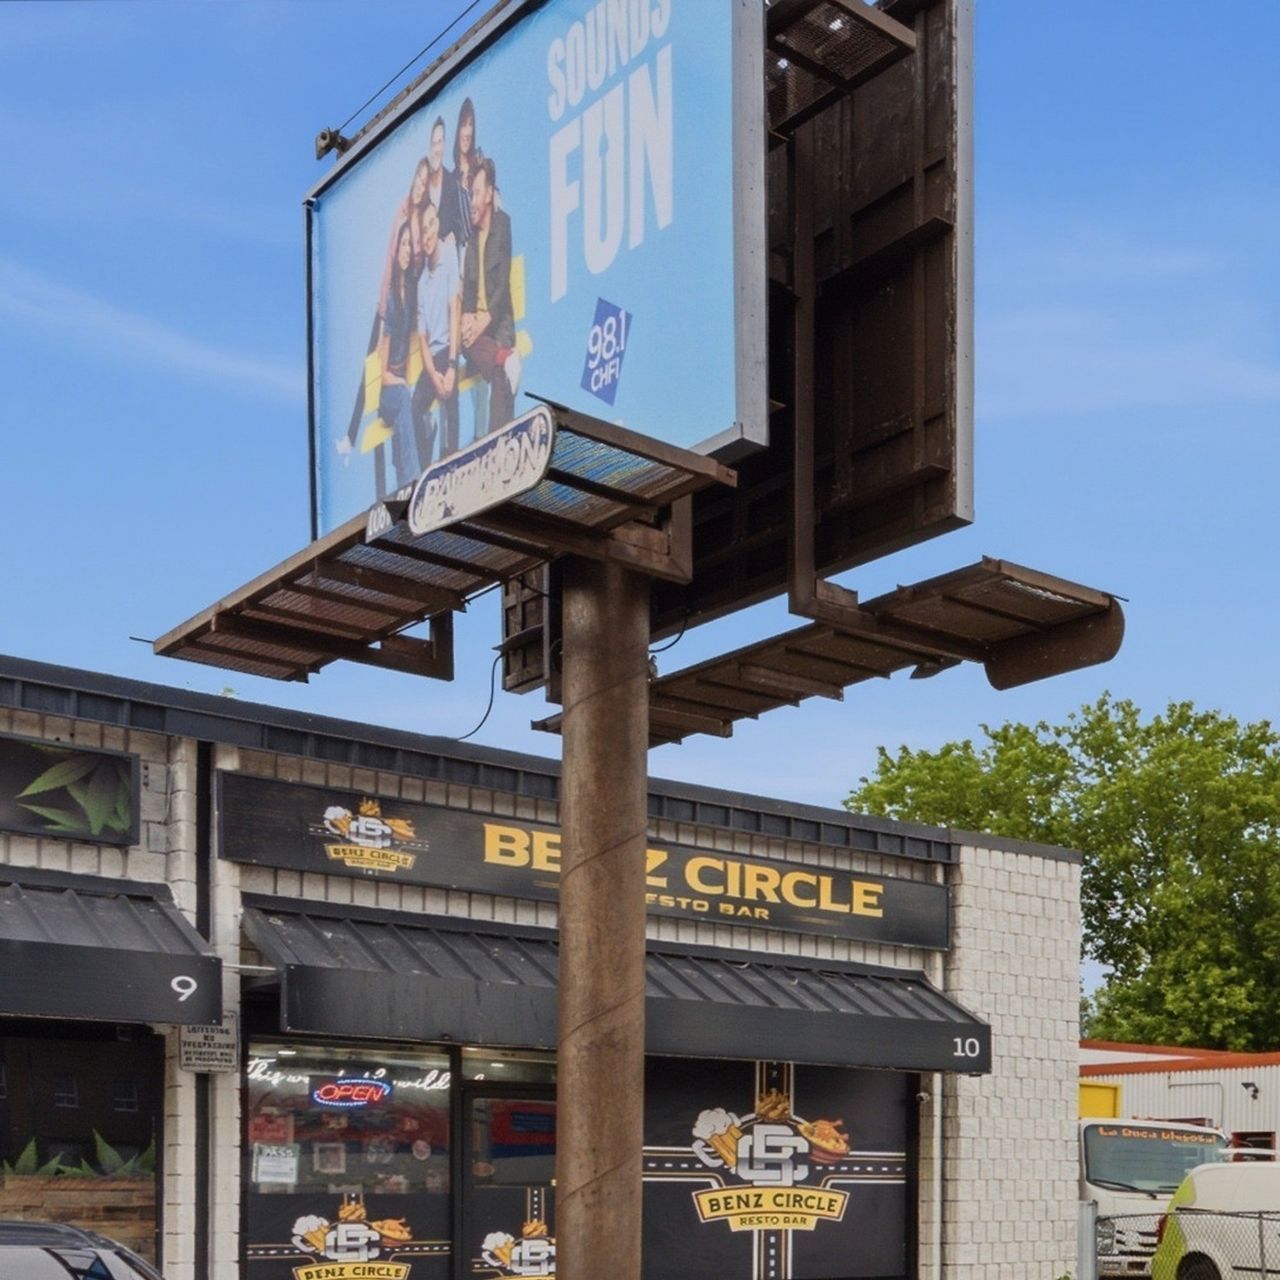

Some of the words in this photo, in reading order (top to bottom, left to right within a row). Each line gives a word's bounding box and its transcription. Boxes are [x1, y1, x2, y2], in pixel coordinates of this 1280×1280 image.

[549, 43, 673, 303] FUN
[588, 310, 626, 369] 98.1
[591, 358, 619, 391] CHFI
[483, 823, 668, 888] BEZ
[684, 856, 884, 918] CIRCLE
[645, 893, 709, 912] ESTO
[719, 903, 769, 920] BAR
[171, 976, 198, 1002] 9
[952, 1038, 980, 1057] 10
[319, 1085, 384, 1101] OPEN
[708, 1193, 763, 1213] BENZ
[772, 1193, 838, 1213] CIRCLE
[739, 1216, 779, 1226] RESTO
[783, 1215, 807, 1225] BAR
[352, 1266, 402, 1278] CIRCLE
